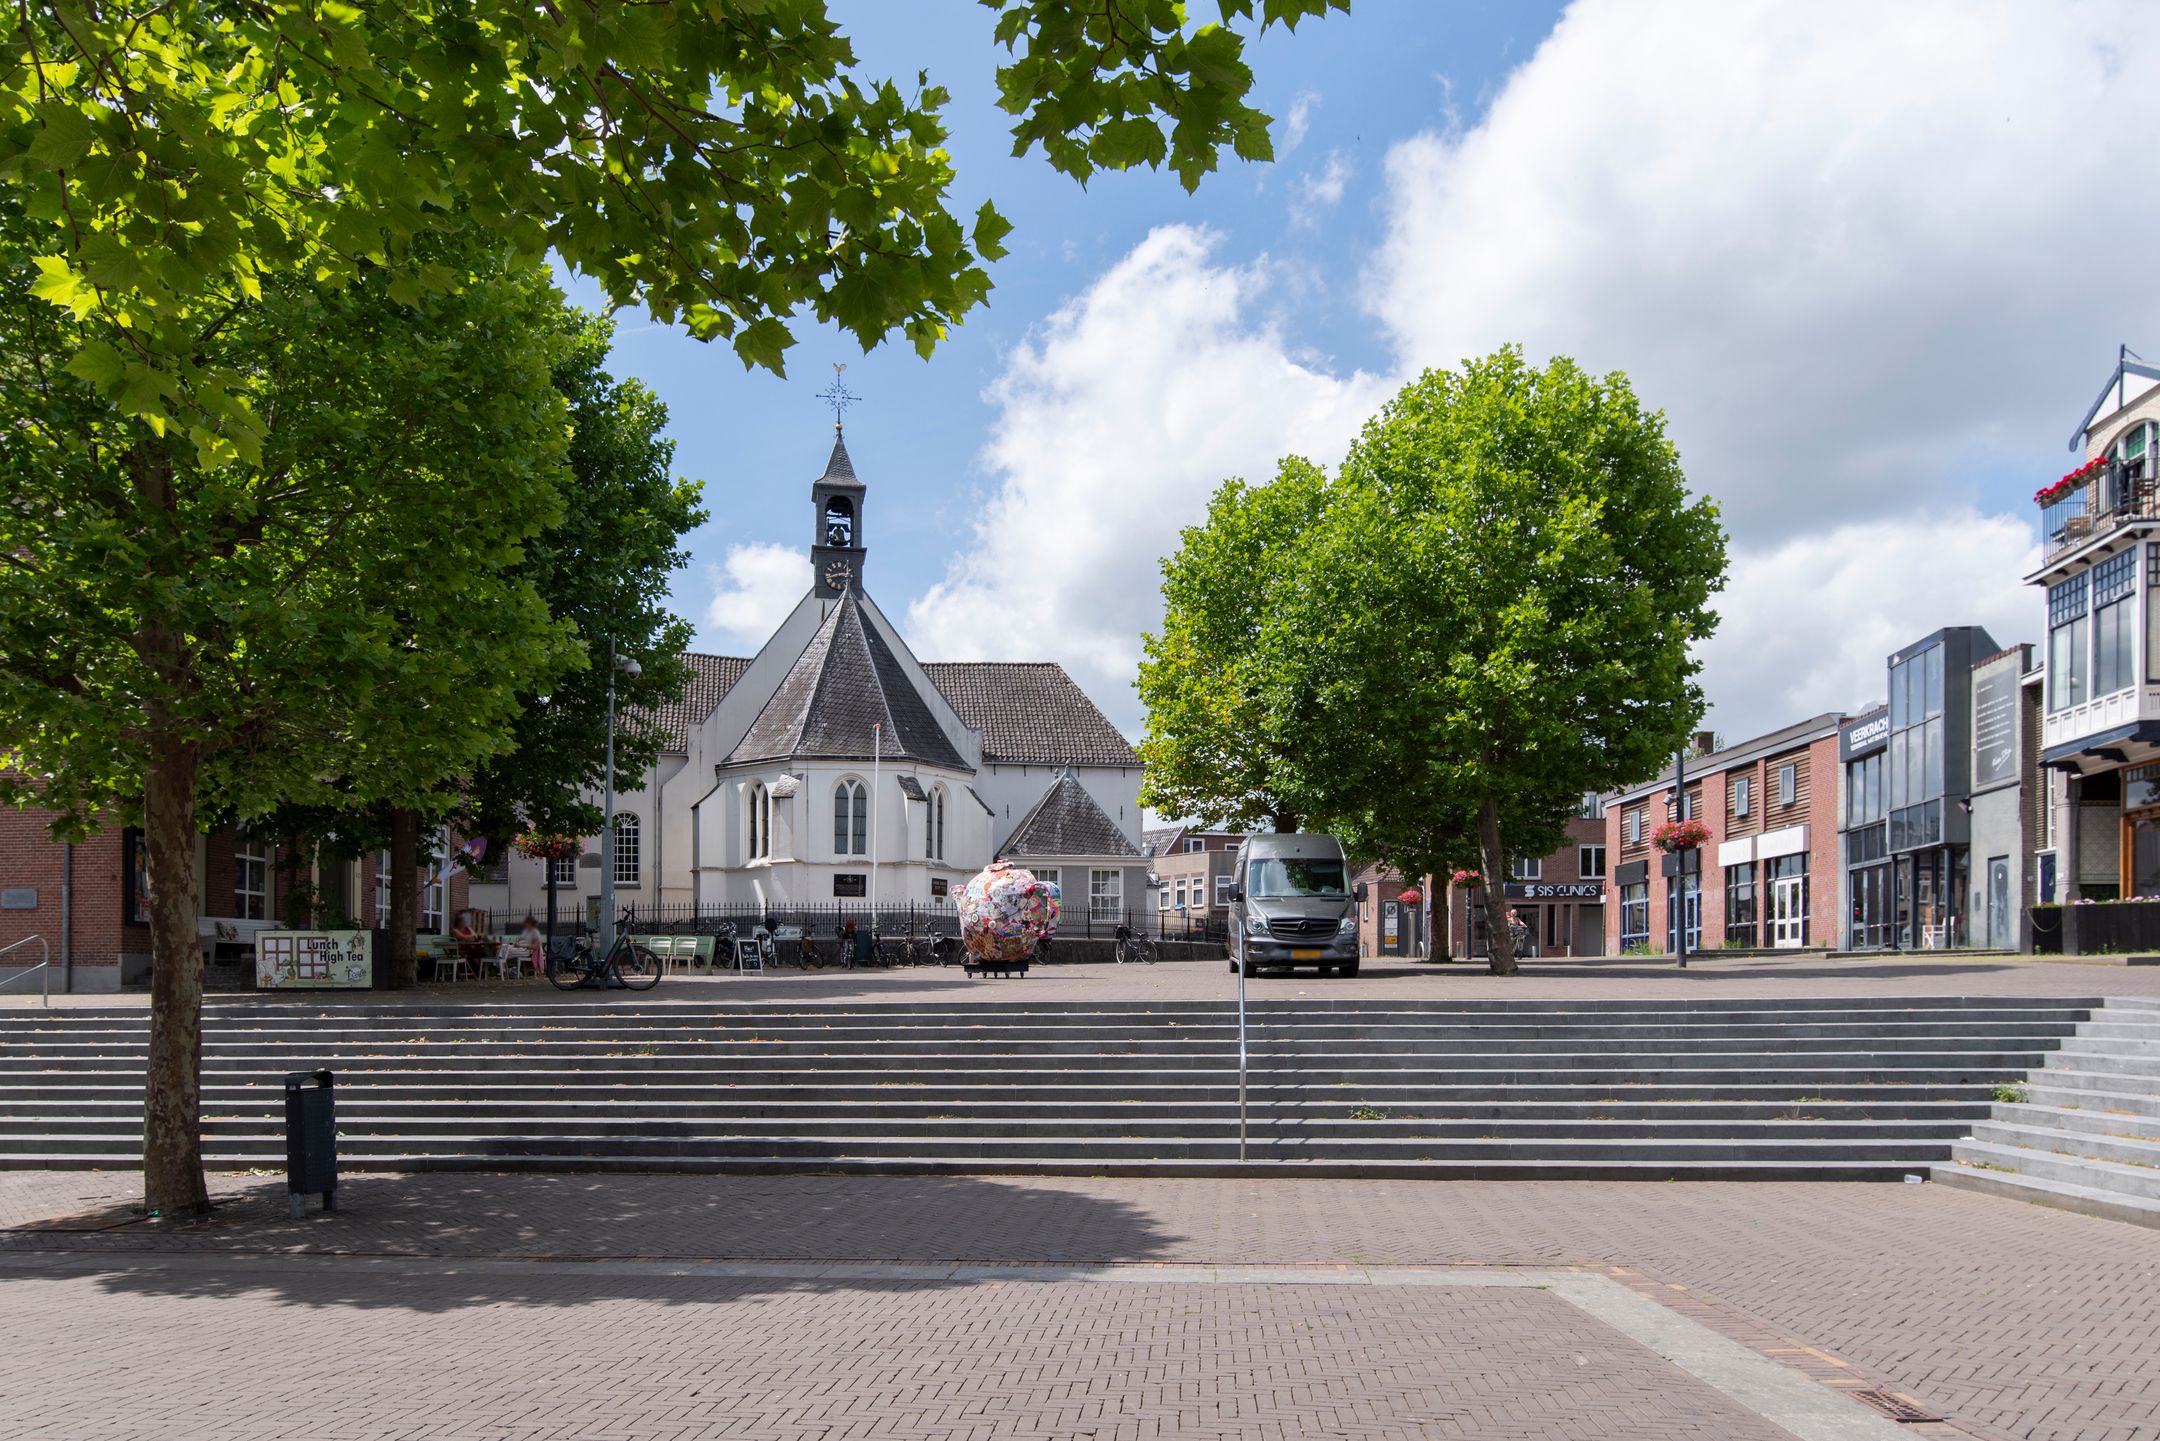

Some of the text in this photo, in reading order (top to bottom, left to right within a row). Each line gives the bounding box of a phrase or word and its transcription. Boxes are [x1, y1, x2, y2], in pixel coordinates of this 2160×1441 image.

[1537, 885, 1554, 896] SIS
[1557, 885, 1597, 896] CLINICS
[307, 938, 338, 950] Lunch
[320, 951, 363, 963] High Tea
